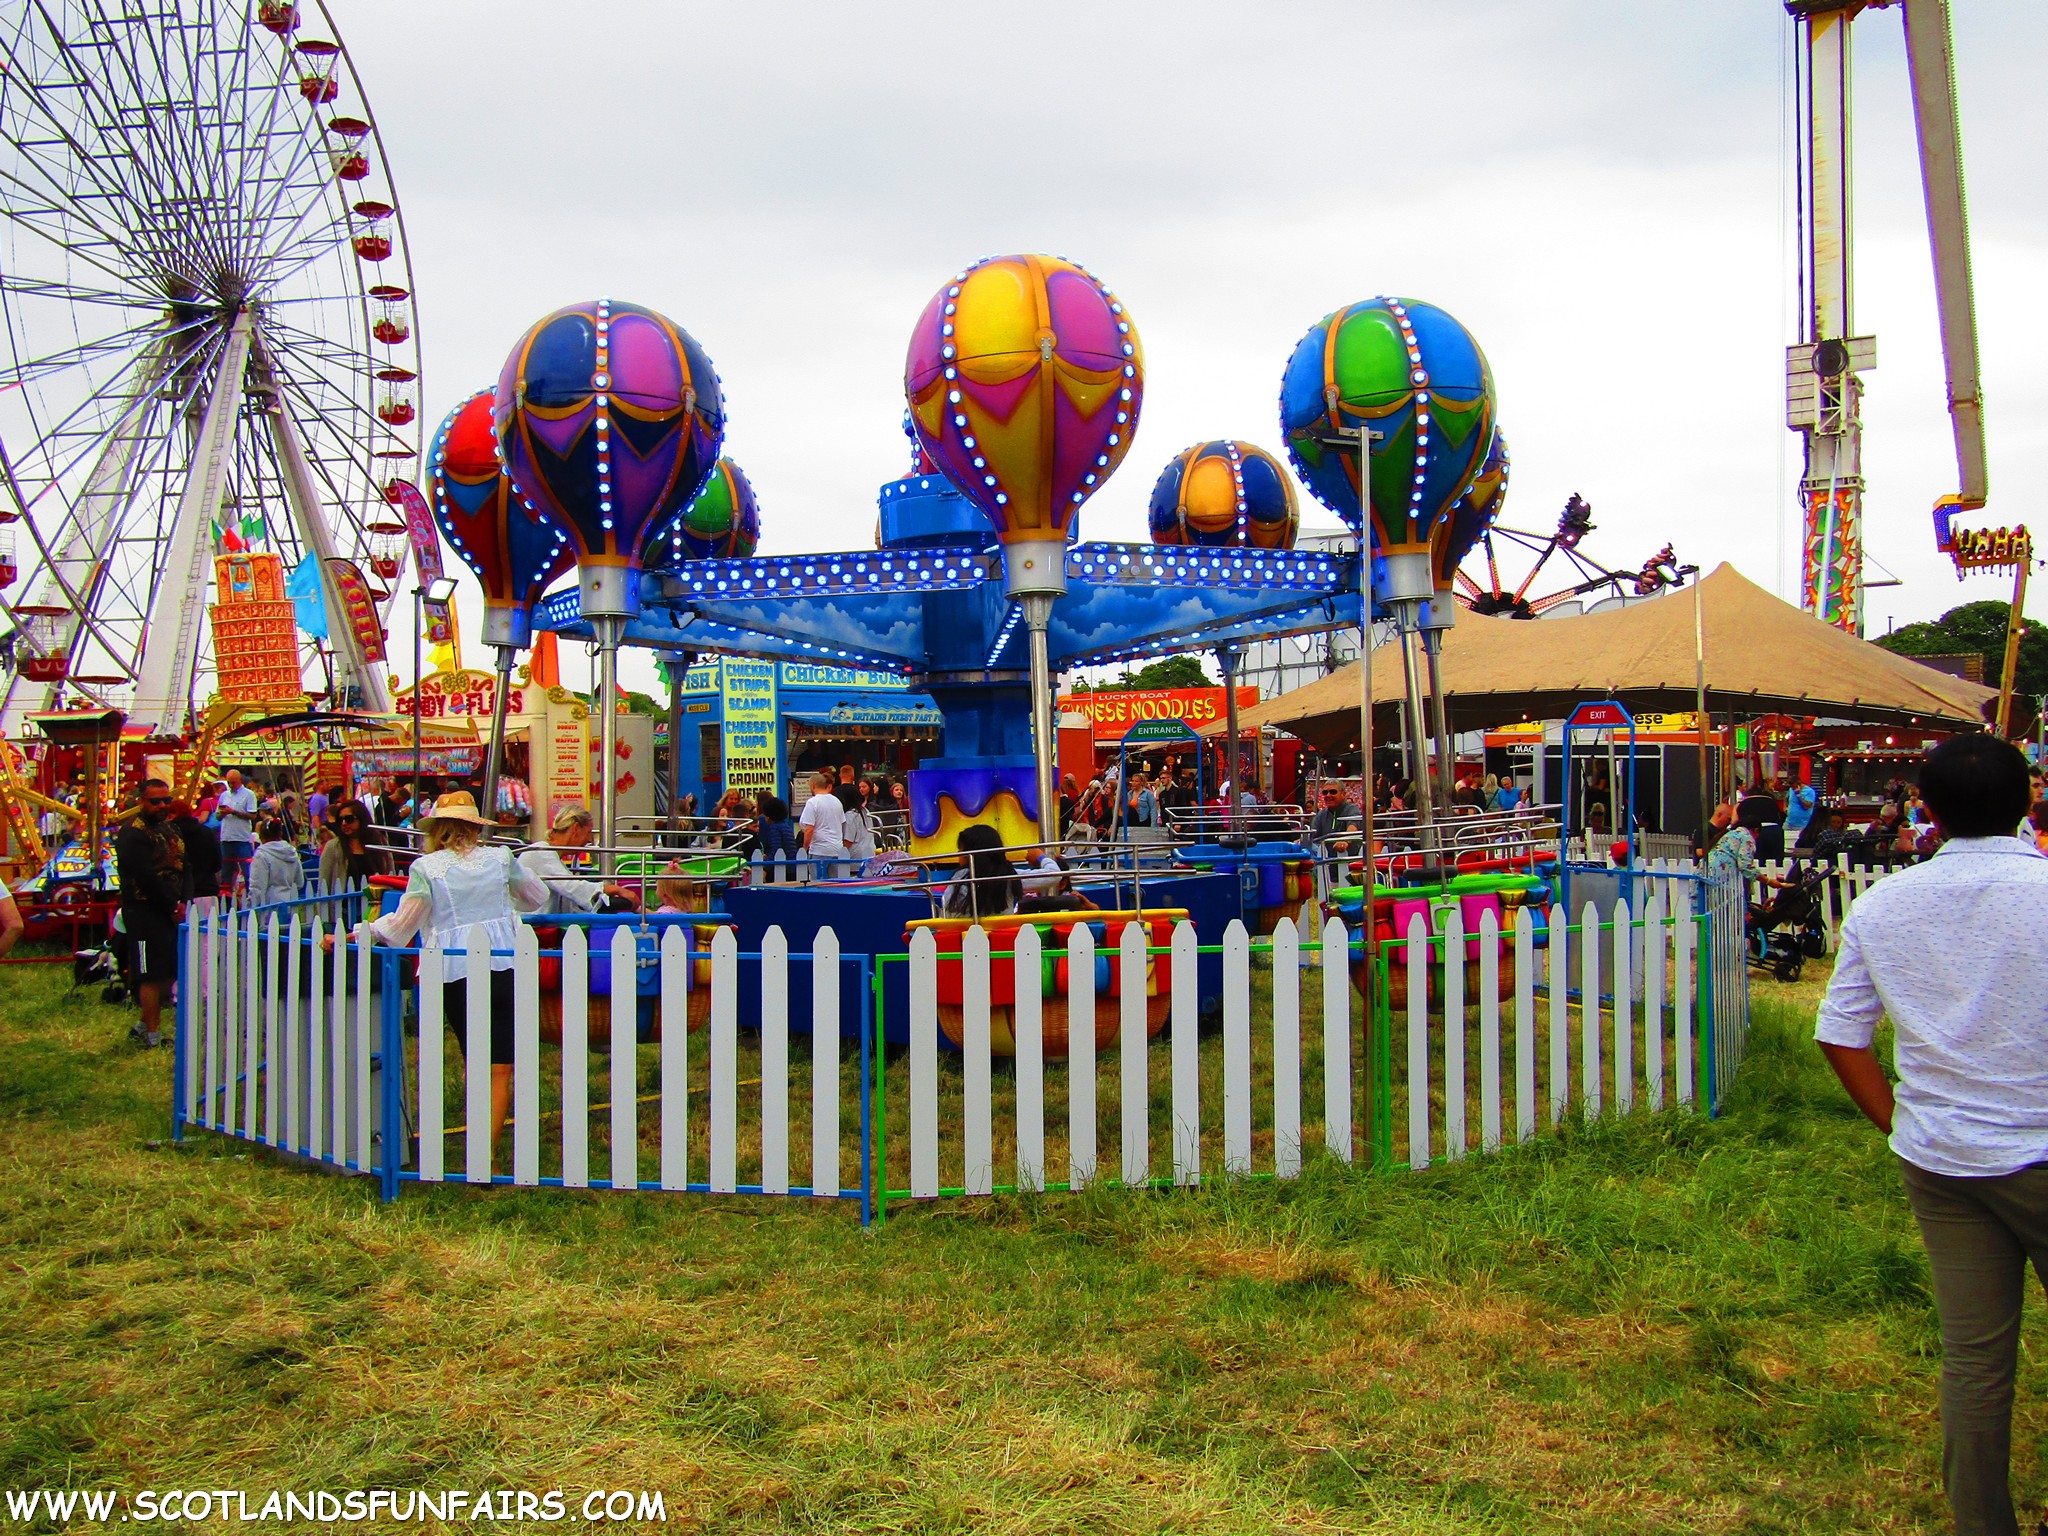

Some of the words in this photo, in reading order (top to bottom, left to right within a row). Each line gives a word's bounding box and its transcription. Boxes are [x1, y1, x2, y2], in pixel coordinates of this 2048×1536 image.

[725, 663, 774, 678] CHICKEN
[785, 664, 857, 684] CHICKEN
[685, 672, 711, 690] ISH
[729, 678, 771, 692] STRIPS
[466, 690, 523, 715] FLS
[1098, 693, 1136, 701] LUCKY
[1139, 691, 1172, 699] BOAT
[728, 697, 772, 711] SCAMPI
[1131, 698, 1216, 721] NOODLES
[888, 711, 913, 722] FINEST
[1589, 710, 1606, 719] EXIT
[725, 720, 776, 735] CHEESEY
[1137, 726, 1183, 735] ENTRANCE
[733, 735, 768, 749] CHIPS
[321, 753, 343, 761] MENU
[726, 757, 776, 771] FRESHLY
[728, 772, 775, 786] GROUND
